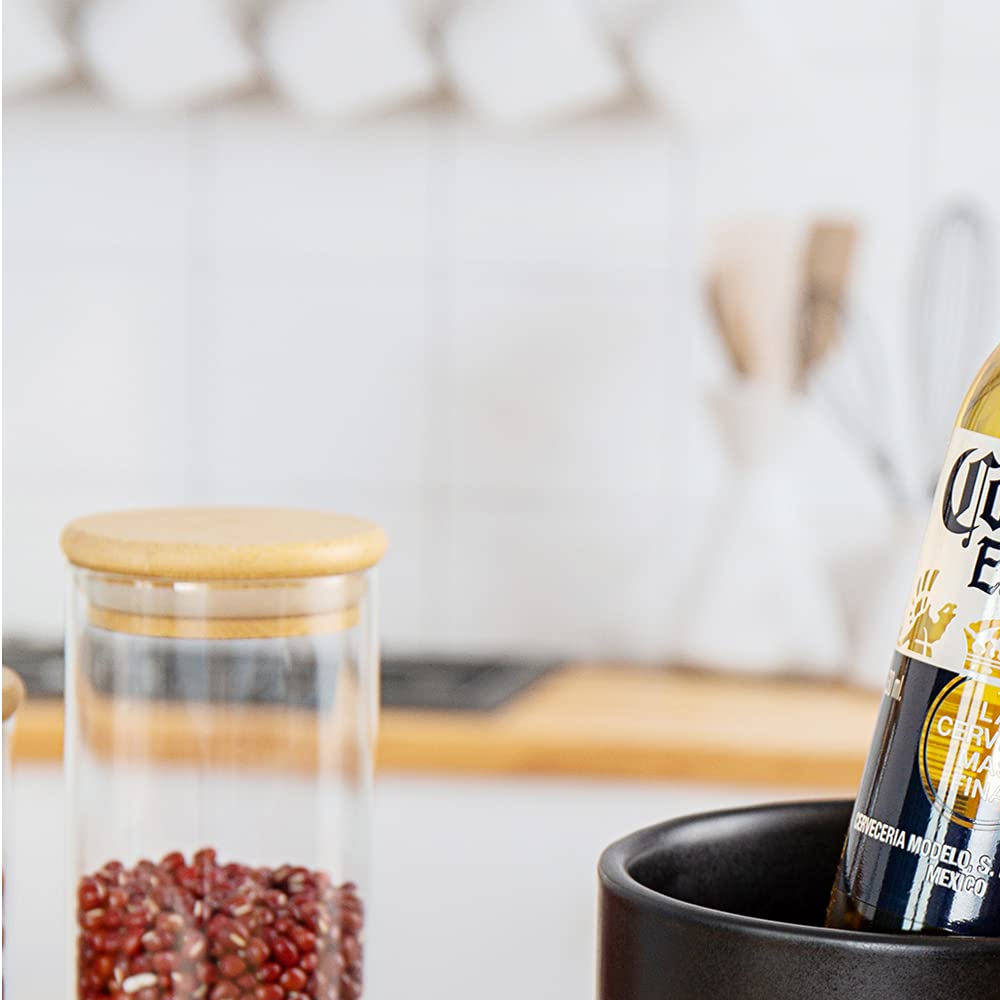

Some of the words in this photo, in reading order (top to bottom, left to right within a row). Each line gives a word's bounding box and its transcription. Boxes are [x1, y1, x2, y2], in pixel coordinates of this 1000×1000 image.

[853, 811, 907, 850] CERVECERIA
[906, 833, 974, 873] MODELO,
[976, 854, 995, 877] S.
[925, 864, 989, 898] MEXICO
